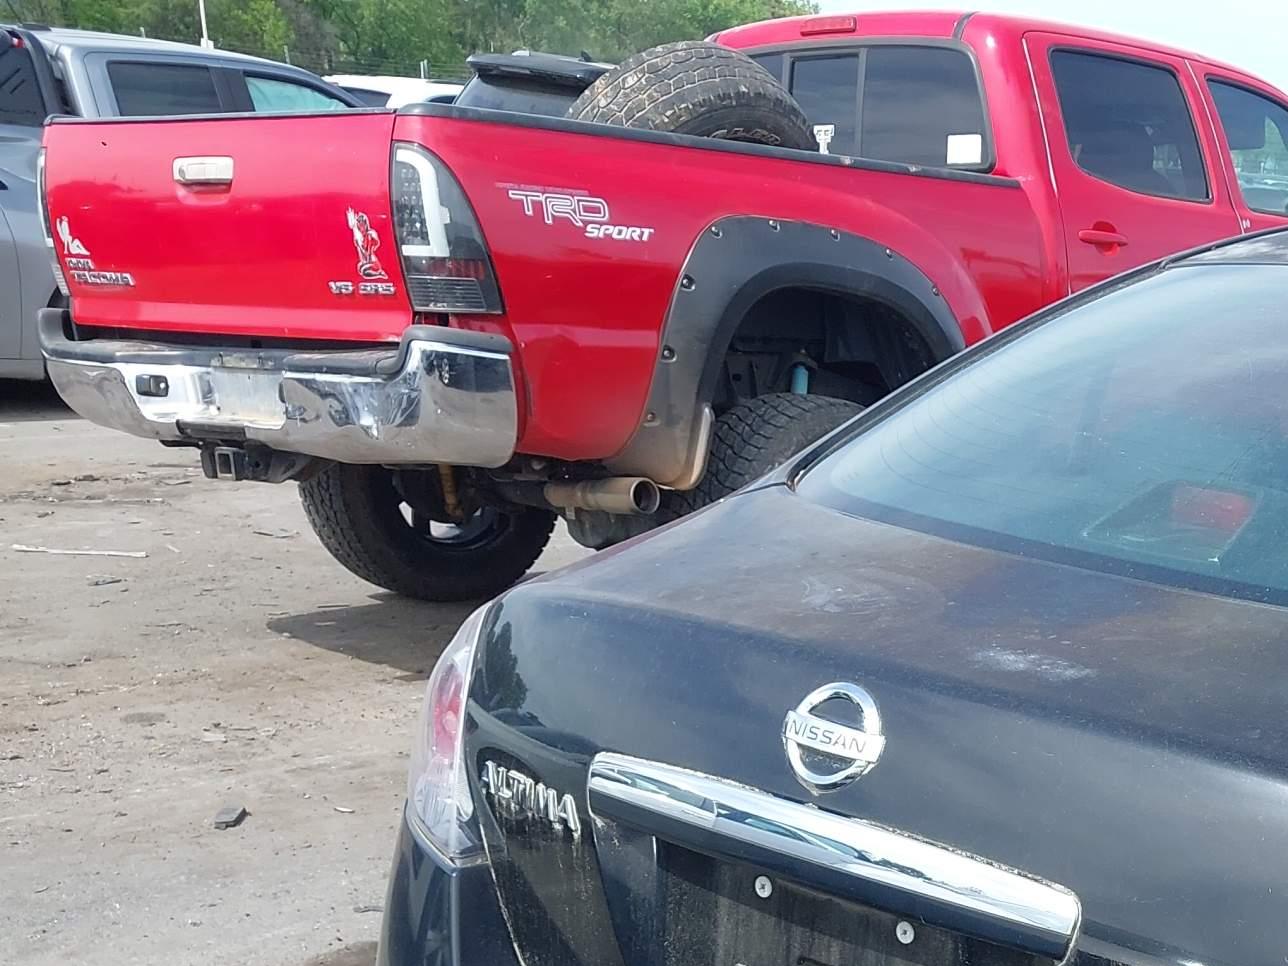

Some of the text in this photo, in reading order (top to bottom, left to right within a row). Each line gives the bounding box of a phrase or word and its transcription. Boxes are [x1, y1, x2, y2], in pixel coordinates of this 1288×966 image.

[508, 189, 609, 227] TRD
[584, 223, 655, 242] SPORT
[70, 270, 136, 286] TACOMA
[788, 719, 867, 753] NISSAN
[481, 760, 581, 836] ALTIMA
